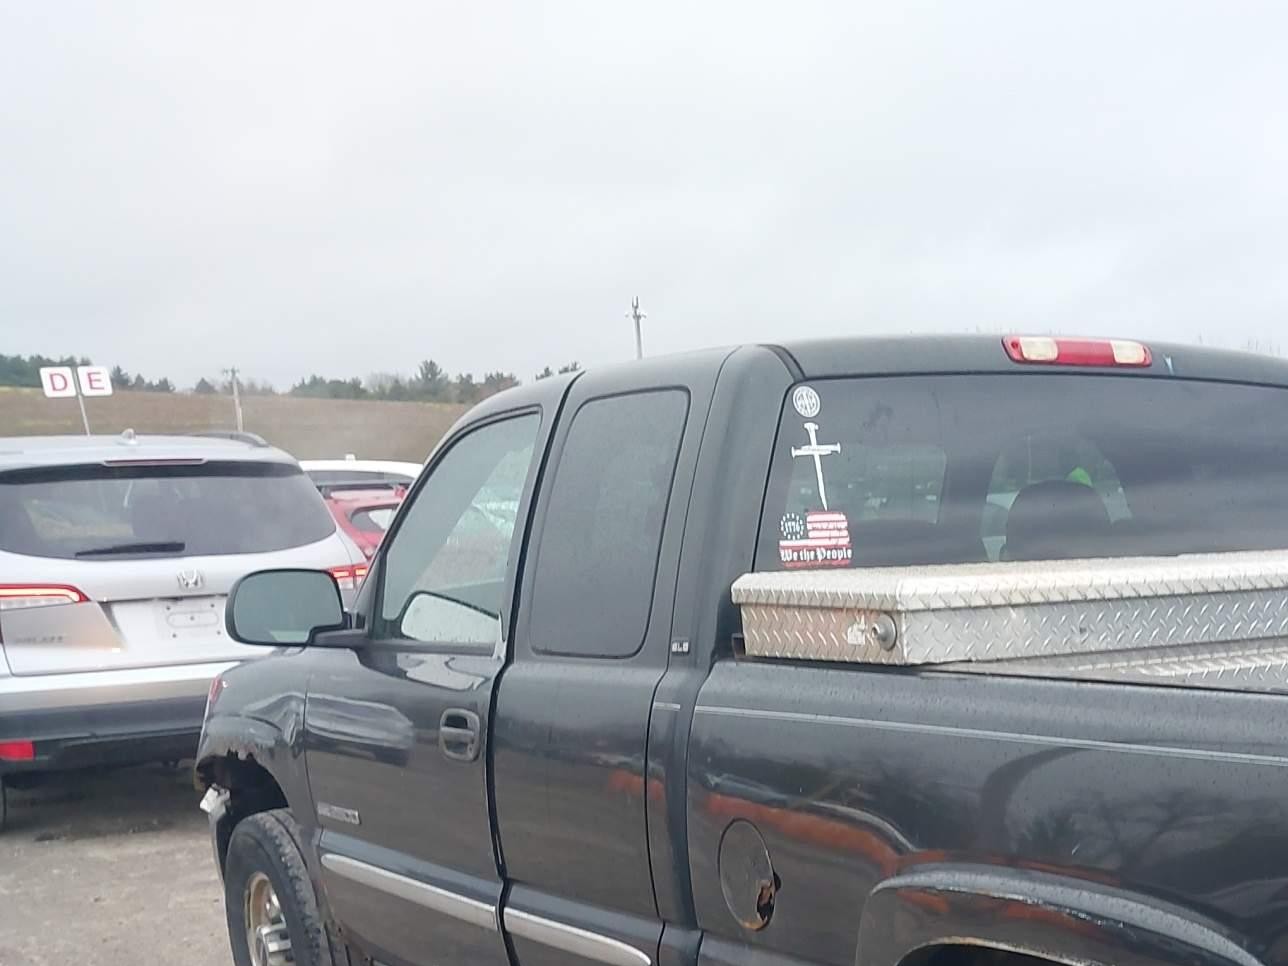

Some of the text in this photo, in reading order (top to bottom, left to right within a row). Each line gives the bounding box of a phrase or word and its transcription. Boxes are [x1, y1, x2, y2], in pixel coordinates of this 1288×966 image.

[48, 372, 68, 392] D
[86, 371, 105, 391] E
[784, 521, 801, 533] 1776
[780, 547, 853, 563] We the People
